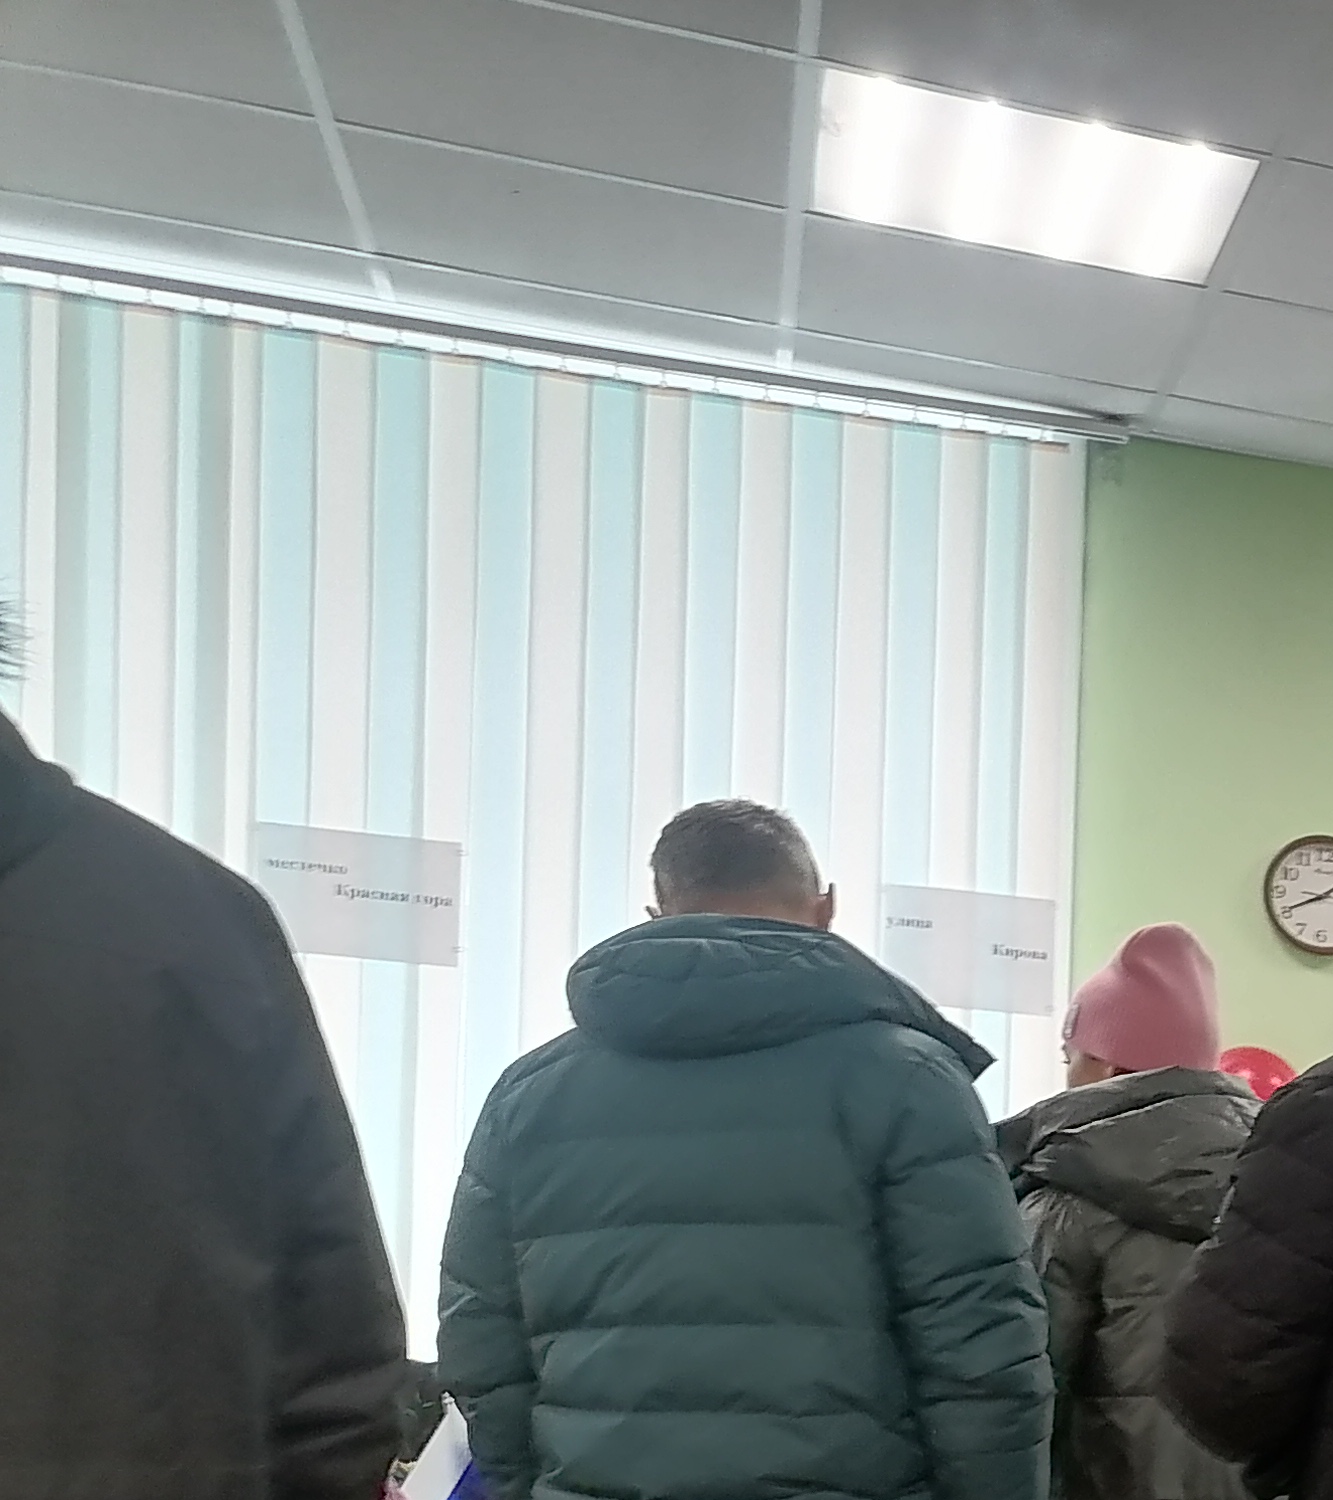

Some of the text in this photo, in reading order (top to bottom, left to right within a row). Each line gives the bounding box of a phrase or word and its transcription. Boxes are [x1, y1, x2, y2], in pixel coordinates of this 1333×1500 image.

[1295, 851, 1311, 866] 11
[1282, 866, 1299, 881] 10
[1272, 885, 1286, 898] 9
[1281, 906, 1293, 919] 8
[1295, 922, 1307, 935] 7
[1316, 930, 1327, 942] 6
